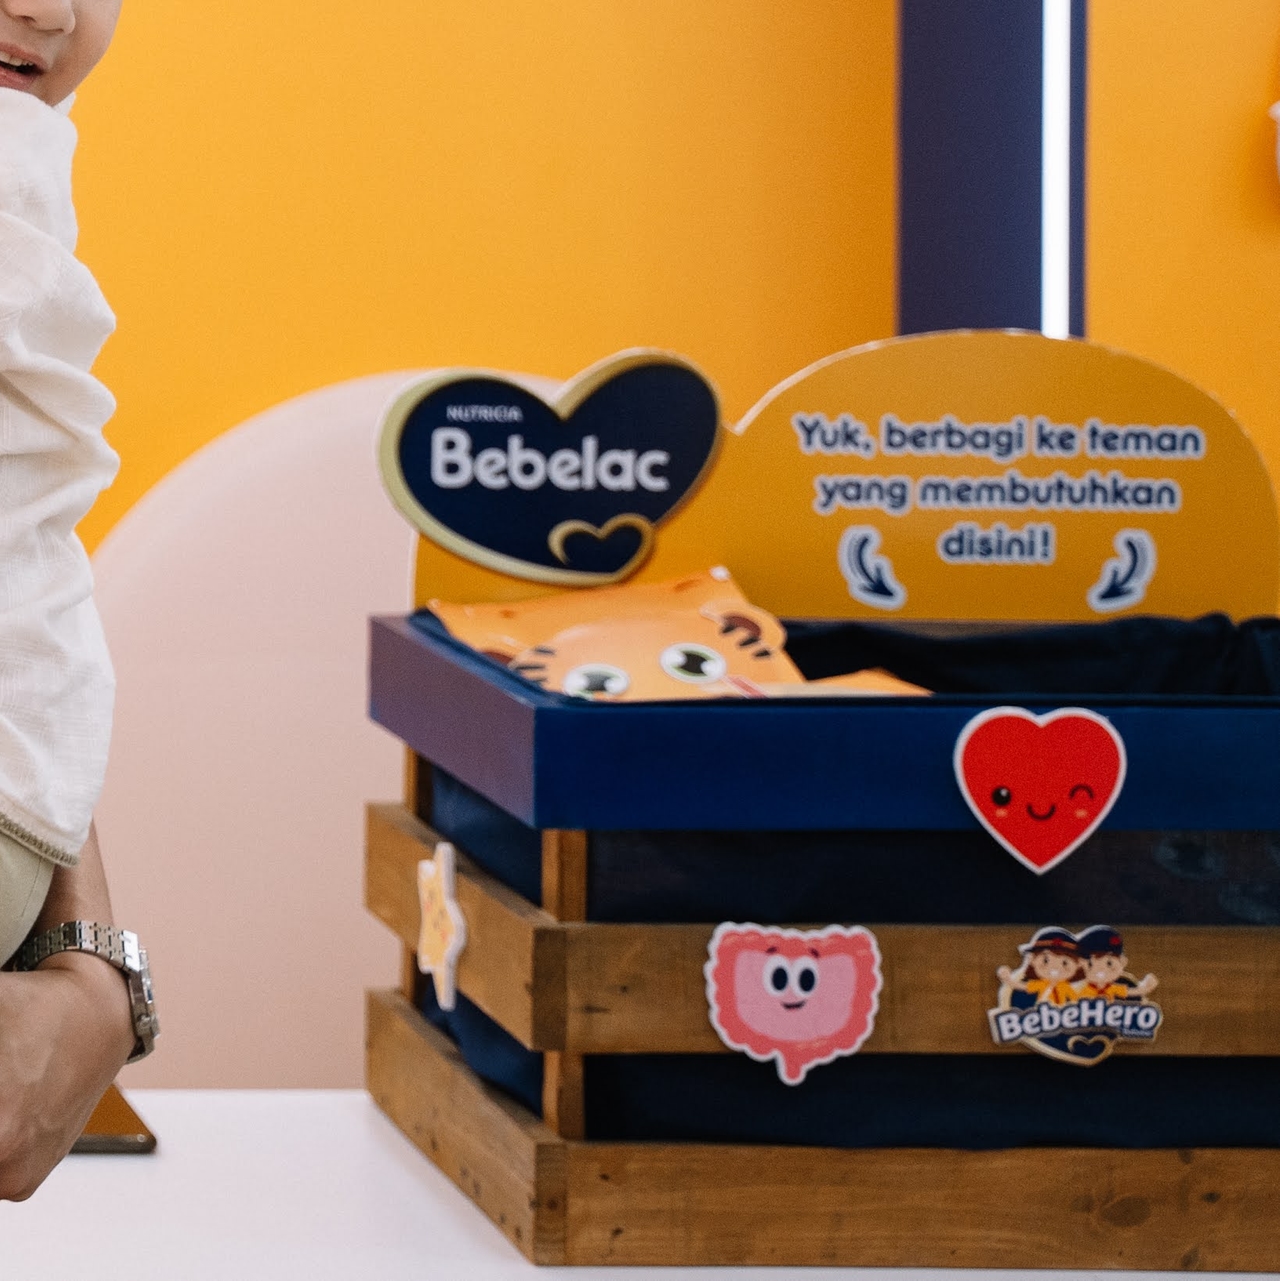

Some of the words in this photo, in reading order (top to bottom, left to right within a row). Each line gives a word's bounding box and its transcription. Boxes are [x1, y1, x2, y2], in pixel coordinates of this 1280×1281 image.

[446, 404, 523, 422] NUTRICIA
[795, 417, 874, 456] Yuk,
[883, 417, 1026, 459] berbagi
[1036, 419, 1078, 453] ke
[1087, 421, 1203, 455] teman
[430, 426, 671, 492] Bebelac
[816, 477, 909, 511] yang
[919, 474, 1178, 507] membutuhkan
[941, 524, 1053, 560] disini!
[996, 999, 1159, 1042] BebeHero
